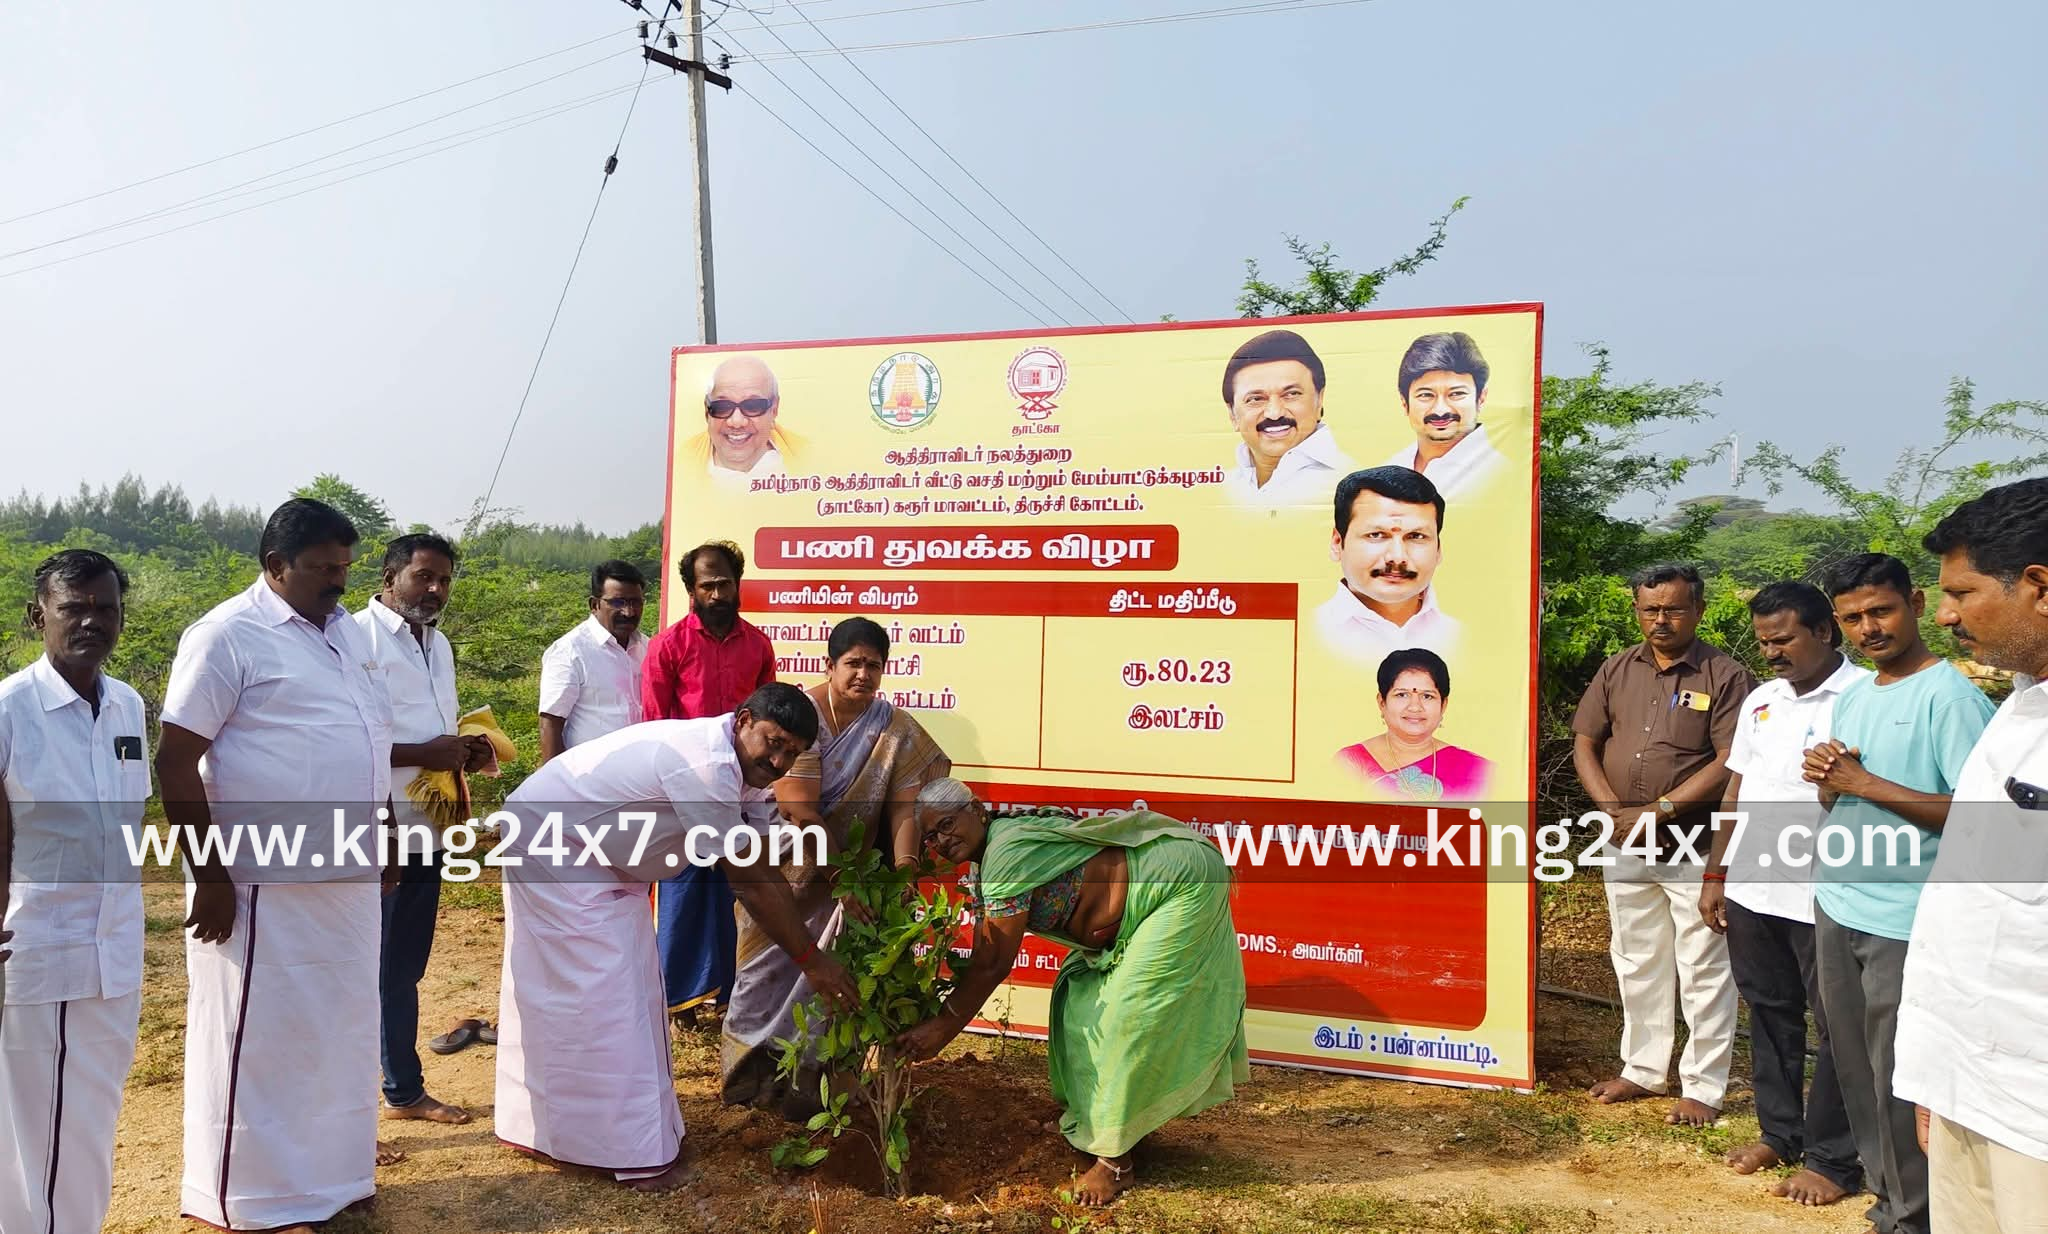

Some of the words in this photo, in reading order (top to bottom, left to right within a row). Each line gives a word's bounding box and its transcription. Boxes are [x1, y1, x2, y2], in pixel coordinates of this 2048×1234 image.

[1011, 422, 1061, 437] தாட்கோ
[885, 446, 984, 466] ஆதிதிராவிடர்
[988, 444, 1073, 465] நலத்துறை
[750, 474, 822, 494] தமிழ்நாடு
[825, 471, 921, 491] ஆதிதிராவிடர்
[925, 471, 962, 489] வீட்டு
[966, 470, 1004, 489] வசதி
[1008, 469, 1067, 490] மற்றும்
[1071, 465, 1224, 488] மேம்பாட்டுக்கழகம்
[817, 498, 890, 516] (தாட்கோ)
[893, 496, 930, 515] கரூர்
[934, 495, 1011, 514] மாவட்டம்,
[1014, 495, 1066, 515] திருச்சி
[1069, 493, 1144, 512] கோட்டம்.
[780, 535, 874, 559] பணி
[882, 533, 1033, 568] துவக்க
[1042, 533, 1155, 568] விழா
[768, 584, 854, 606] பணியின்
[858, 585, 919, 610] விபரம்
[1108, 589, 1152, 612] திட்ட
[1158, 588, 1237, 616] மதிப்பீடு
[908, 622, 965, 645] வட்டம்
[1122, 659, 1232, 687] ரூ.80.23
[892, 687, 957, 710] கட்டடம்
[1128, 703, 1225, 731] இலட்சம்
[1314, 1025, 1364, 1051] இடம்
[1383, 1031, 1499, 1069] பன்னப்பட்டி.
